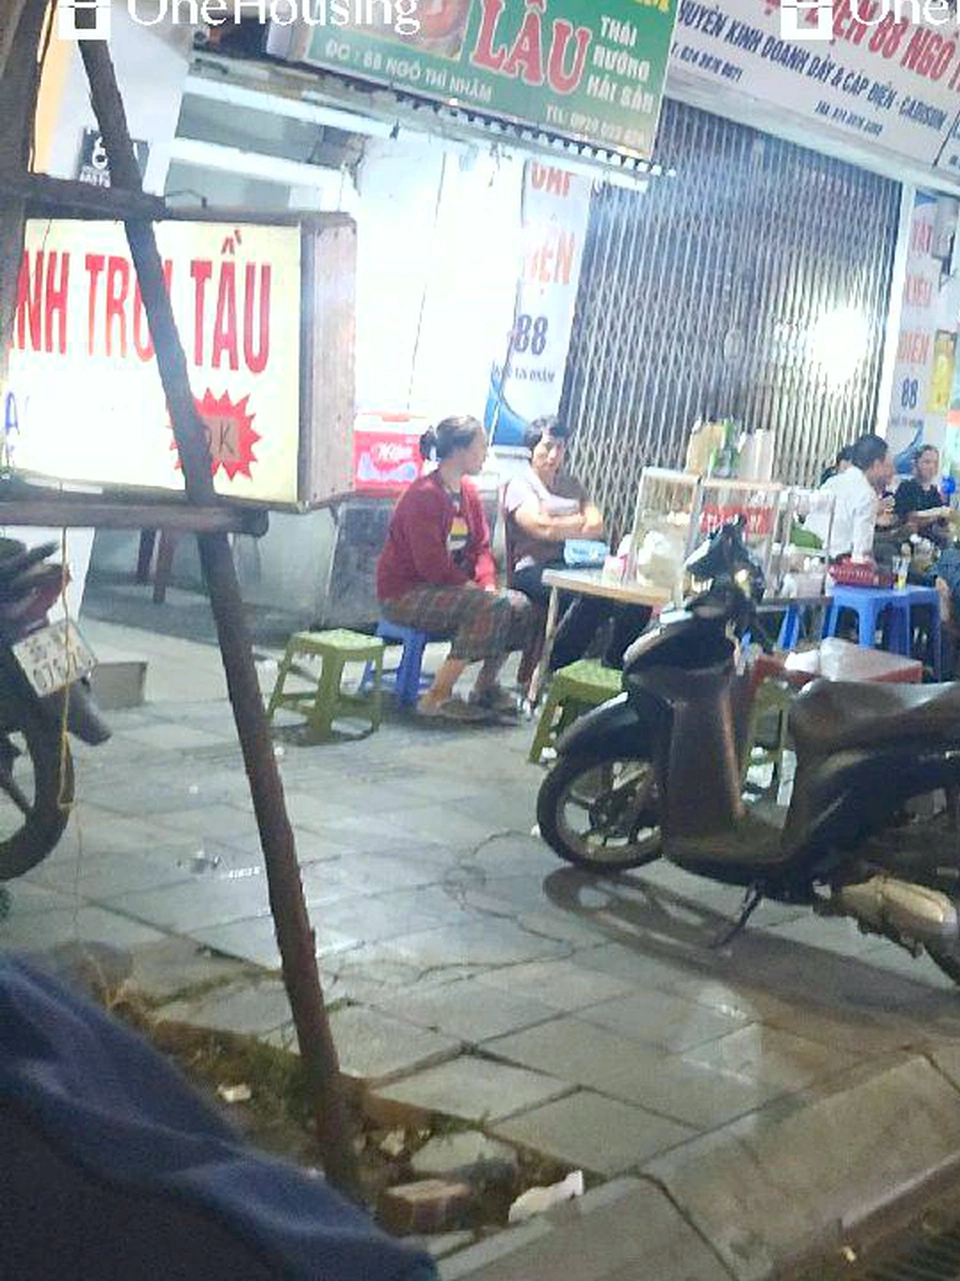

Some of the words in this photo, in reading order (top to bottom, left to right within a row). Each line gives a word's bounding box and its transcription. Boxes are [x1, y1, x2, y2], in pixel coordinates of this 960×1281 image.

[723, 18, 765, 55] KINH
[760, 34, 811, 73] DOANH
[867, 10, 911, 59] 88
[513, 314, 549, 356] 88
[901, 377, 919, 410] 88
